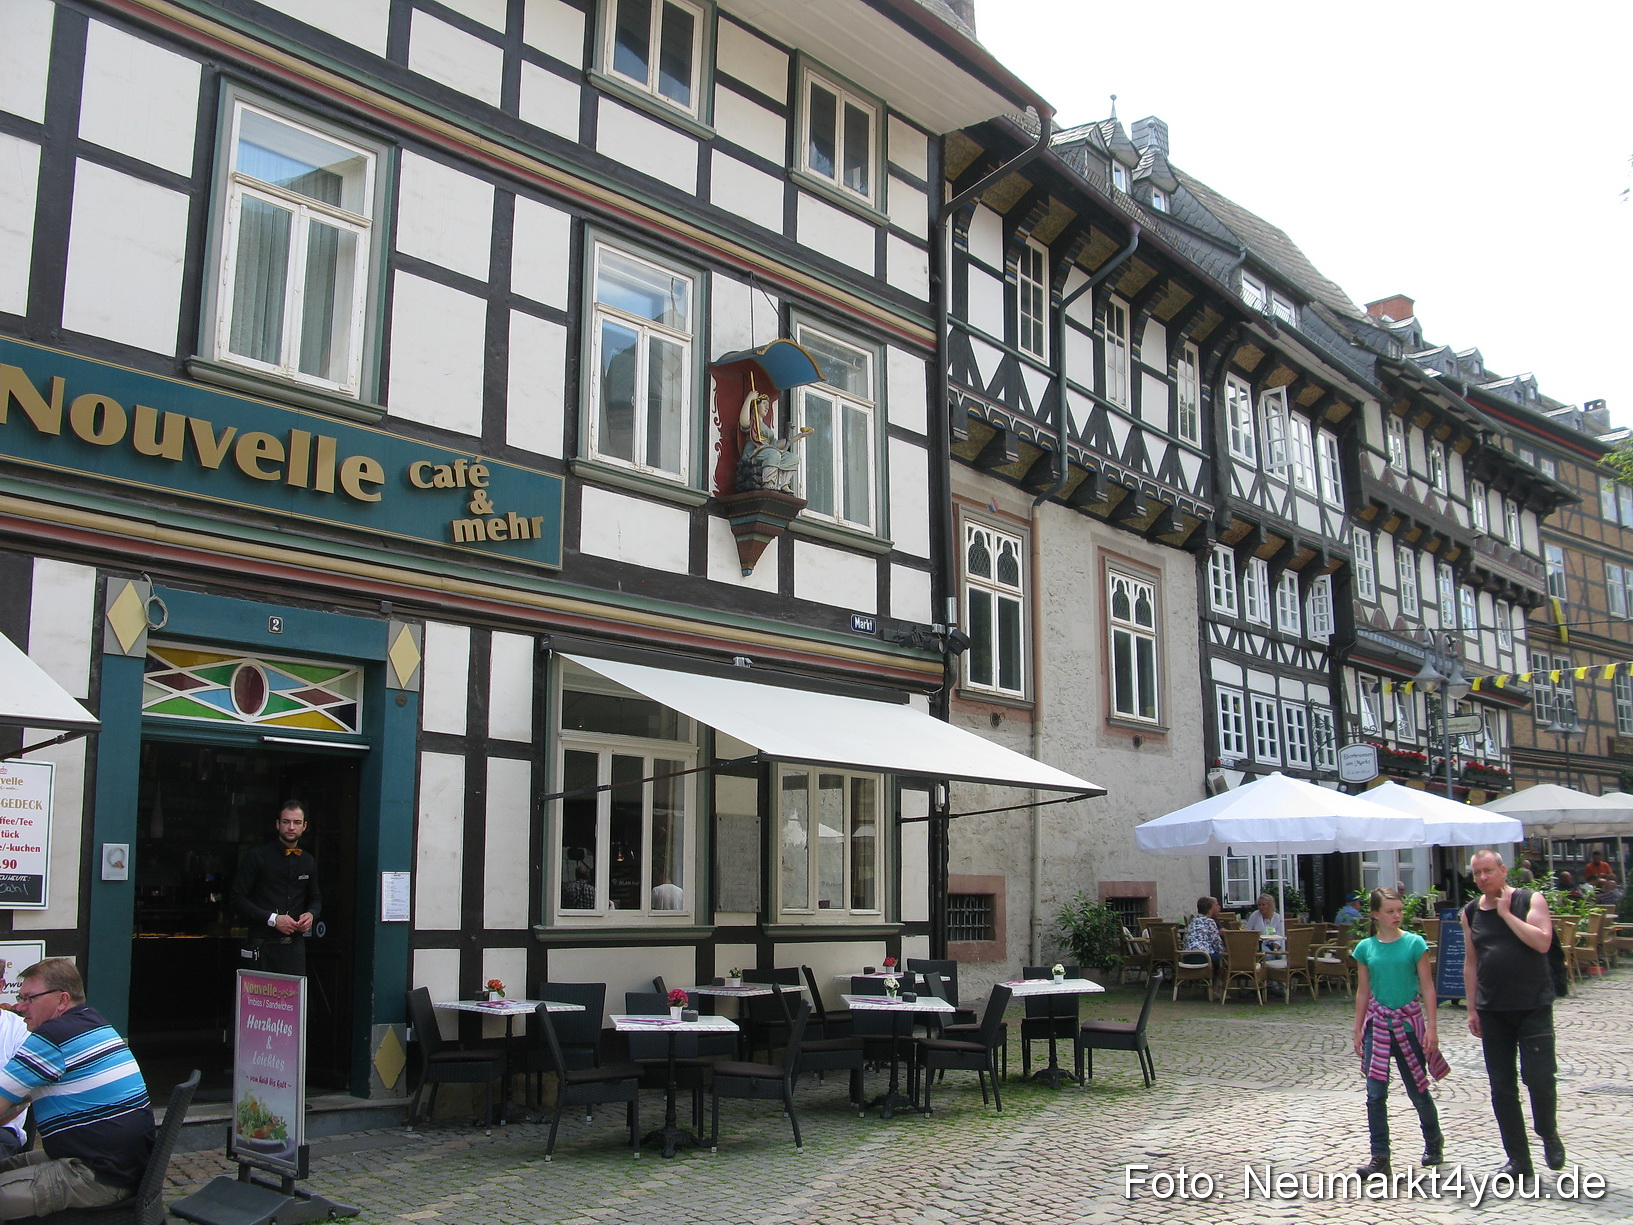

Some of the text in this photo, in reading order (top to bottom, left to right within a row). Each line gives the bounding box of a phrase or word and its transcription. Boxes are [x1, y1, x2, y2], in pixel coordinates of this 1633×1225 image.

[0, 365, 386, 503] Nouvelle
[408, 456, 490, 489] Café
[468, 489, 495, 515] &
[451, 511, 545, 543] mehr
[272, 618, 280, 631] 2
[854, 616, 873, 631] Markt
[1, 798, 43, 810] GEDECK
[243, 981, 278, 998] Nouvelle
[246, 1014, 293, 1037] Herzhaftes
[265, 1035, 272, 1050] &
[252, 1051, 285, 1072] Leichtes
